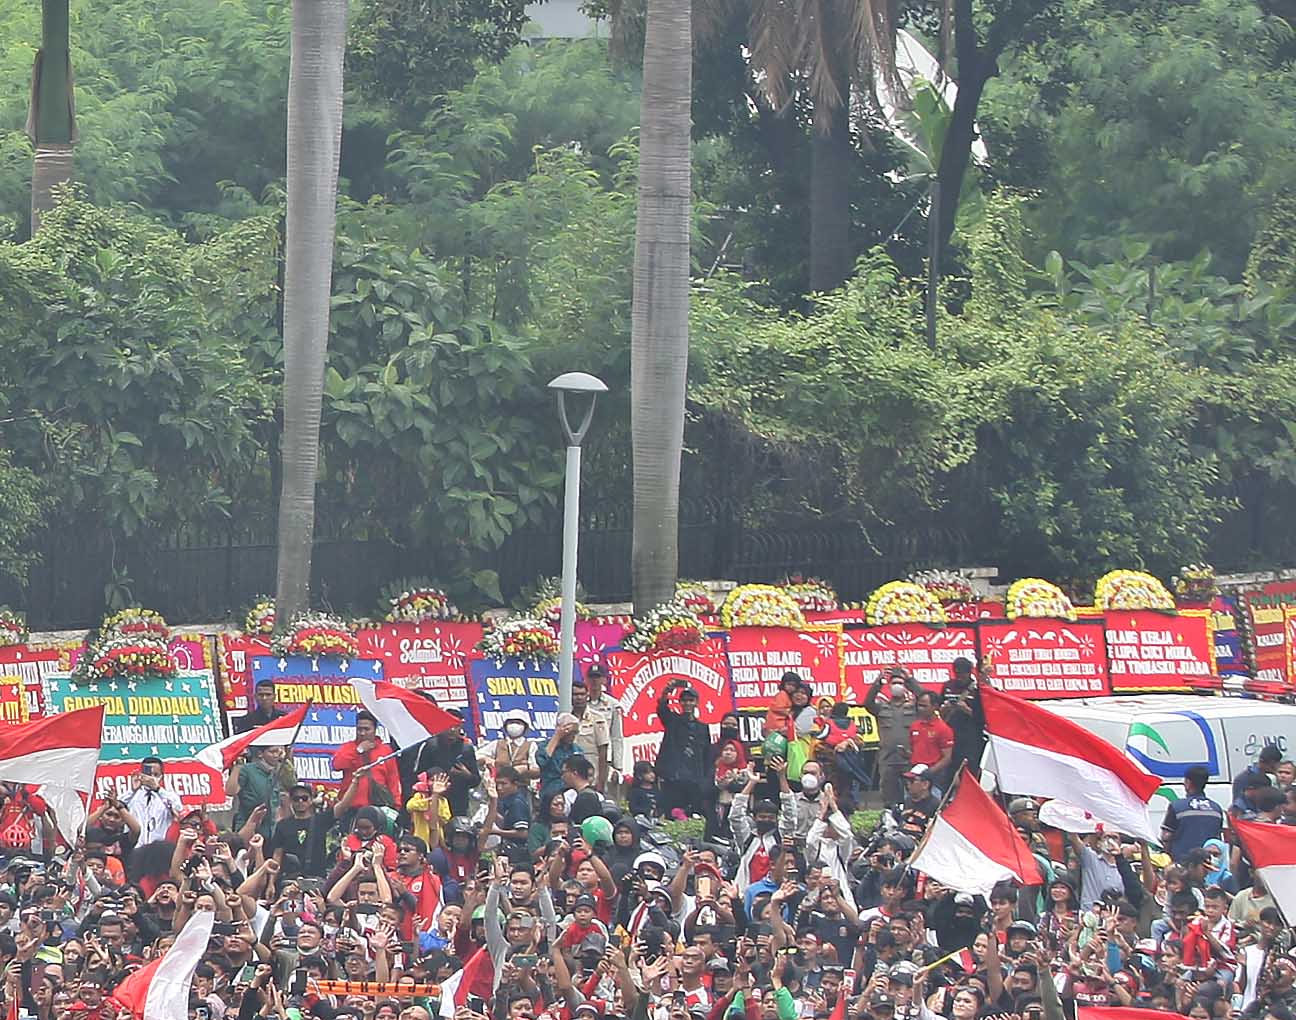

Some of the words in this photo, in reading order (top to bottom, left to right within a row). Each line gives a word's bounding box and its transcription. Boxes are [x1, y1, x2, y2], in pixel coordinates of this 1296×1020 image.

[1141, 646, 1164, 660] CUCI
[732, 666, 760, 683] RUDA
[1177, 660, 1211, 676] JUARA
[274, 684, 321, 704] TERIMA
[486, 678, 526, 697] SIAPA
[735, 682, 761, 698] JUGA
